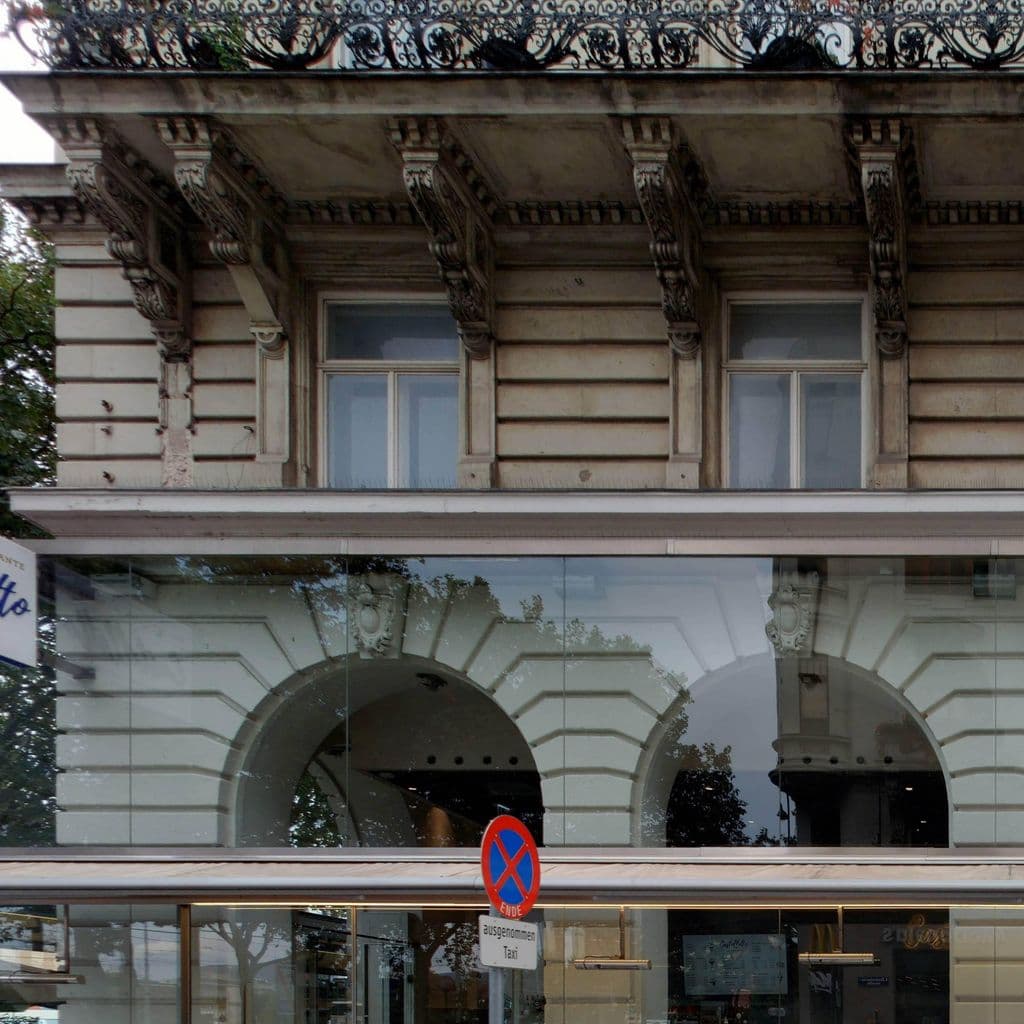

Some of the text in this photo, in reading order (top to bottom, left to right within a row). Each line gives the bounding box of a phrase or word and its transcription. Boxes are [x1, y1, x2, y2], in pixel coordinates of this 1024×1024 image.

[500, 902, 523, 917] ENDE
[483, 924, 536, 942] ausgenommen
[503, 945, 519, 960] Taxi
